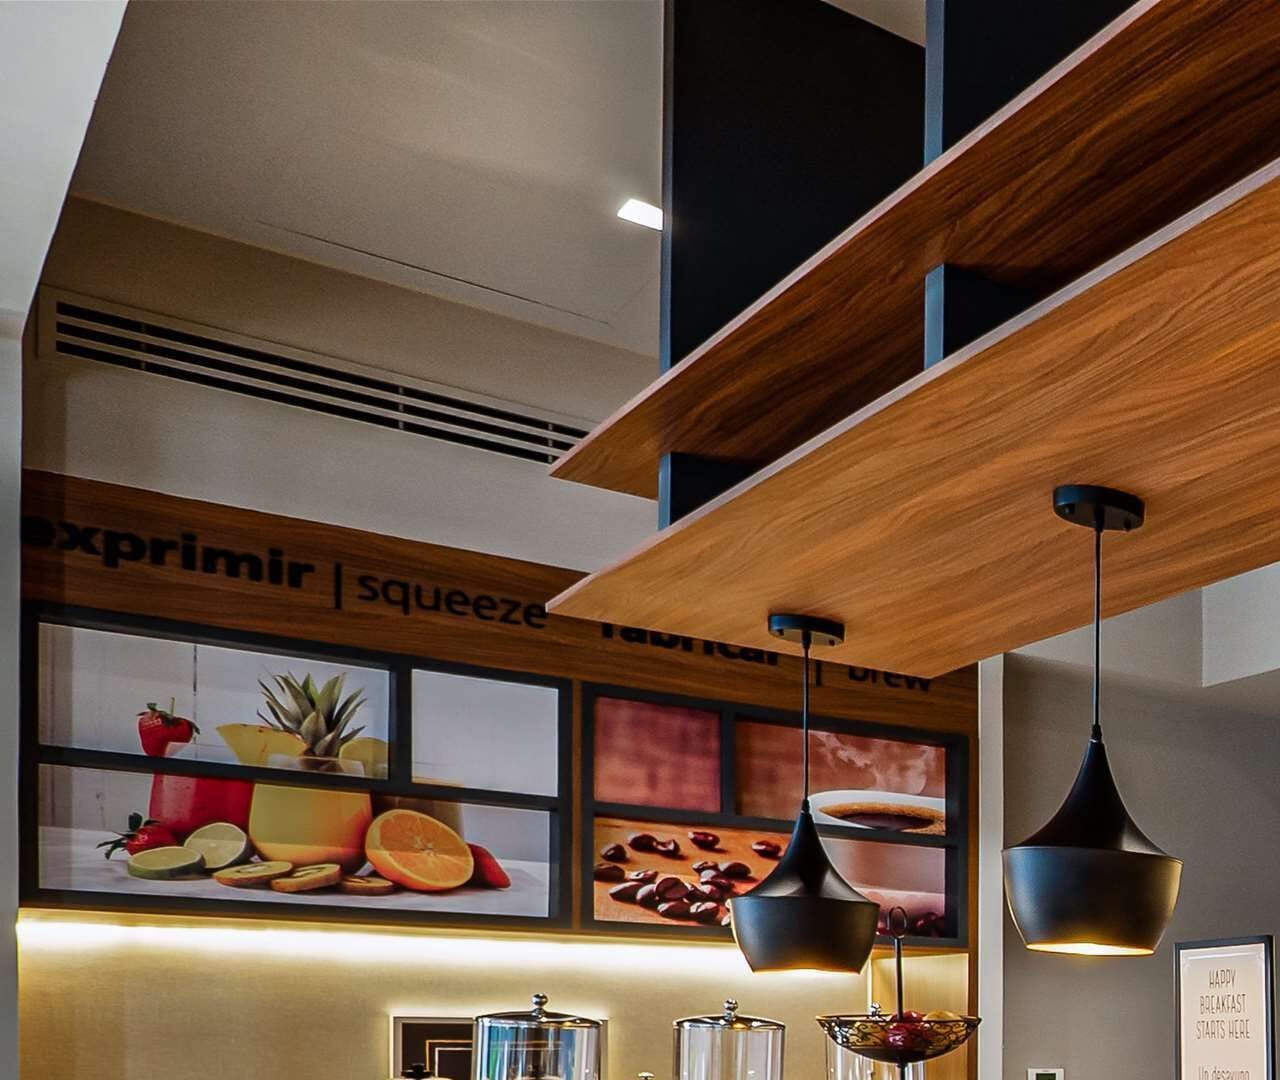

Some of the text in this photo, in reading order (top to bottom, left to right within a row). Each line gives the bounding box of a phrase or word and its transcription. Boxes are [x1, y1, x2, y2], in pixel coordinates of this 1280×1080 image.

[356, 574, 548, 630] squeeze
[1208, 968, 1237, 989] HAPPY
[1199, 993, 1247, 1015] BREAKFAST
[1195, 1018, 1251, 1040] STARTS HERE
